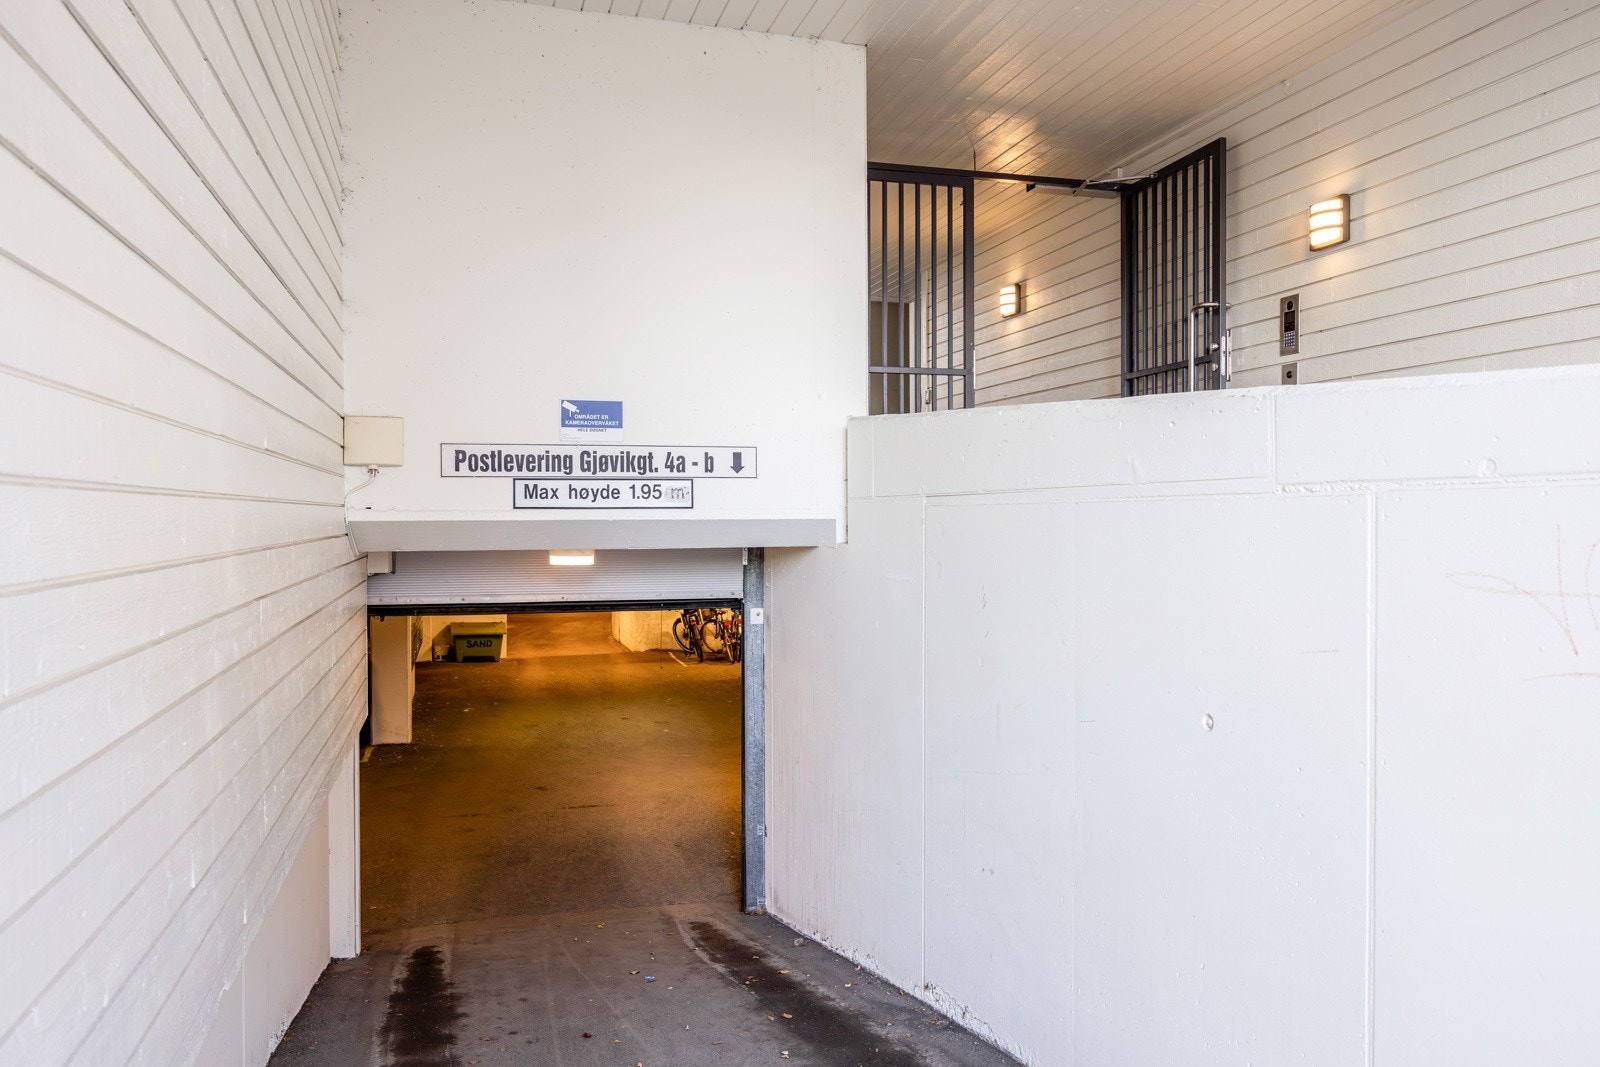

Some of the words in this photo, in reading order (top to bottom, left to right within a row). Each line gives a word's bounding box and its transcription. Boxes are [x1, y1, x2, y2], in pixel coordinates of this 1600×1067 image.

[454, 449, 573, 475] Postlevering
[580, 450, 659, 476] Gjøvikgt.
[664, 451, 686, 473] 4a
[704, 451, 715, 473] b
[524, 483, 559, 499] Max
[568, 483, 621, 502] høyde
[629, 484, 662, 500] 1.95
[466, 639, 493, 648] SAND
